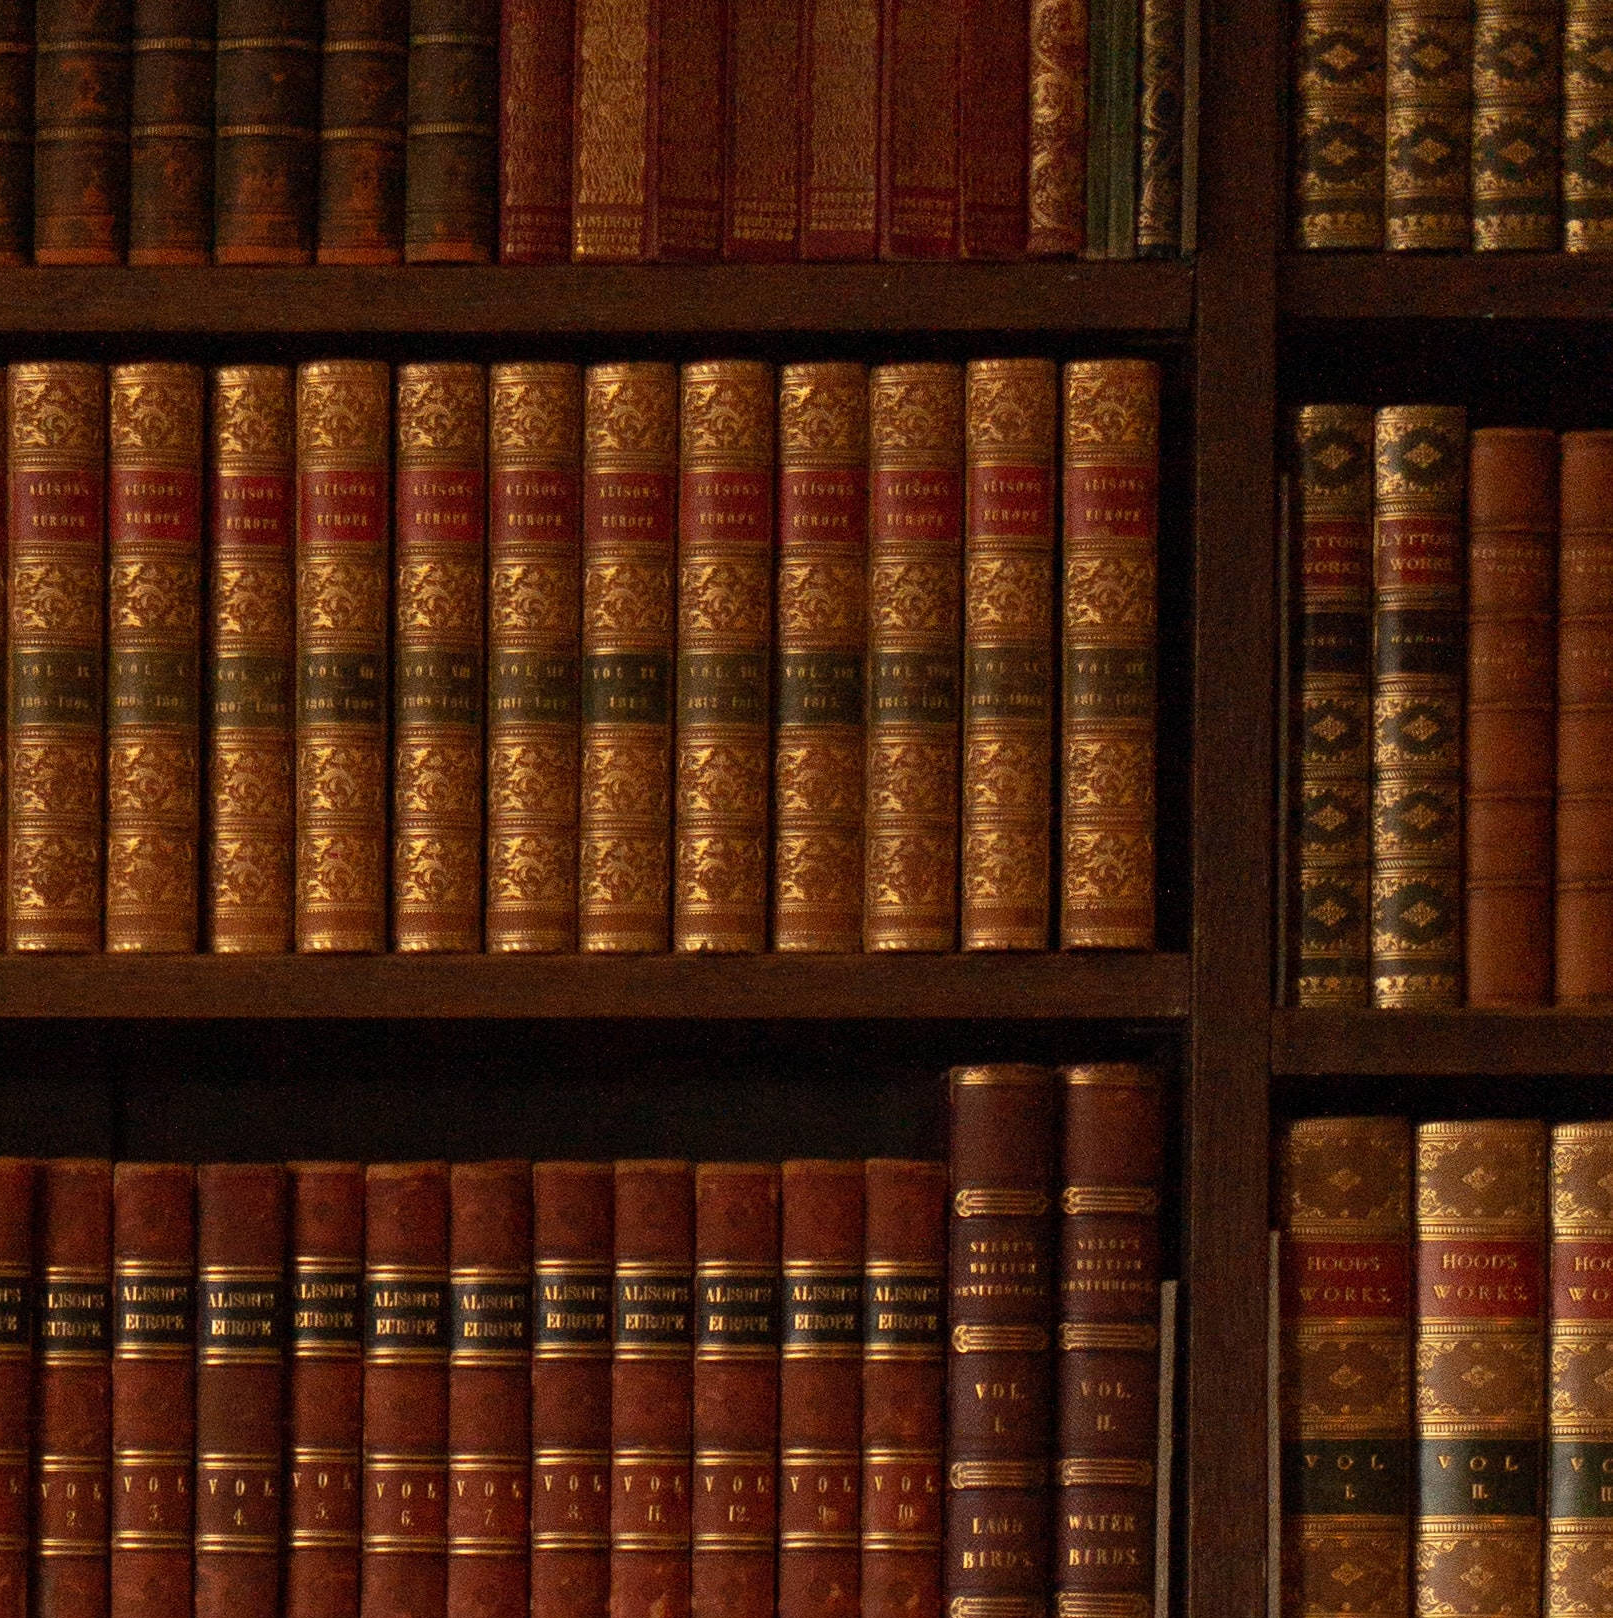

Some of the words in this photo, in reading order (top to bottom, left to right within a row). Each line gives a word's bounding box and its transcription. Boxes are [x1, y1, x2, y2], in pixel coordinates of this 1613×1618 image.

[1299, 1287, 1391, 1302] WORKS.
[1433, 1285, 1527, 1300] WORKS.
[125, 1314, 184, 1330] EUROPE
[211, 1320, 271, 1336] EUROPE
[295, 1312, 354, 1328] EUROPE
[376, 1320, 436, 1335] EUROPE
[546, 1313, 605, 1329] EUROPE
[626, 1314, 684, 1330] EUROPE
[709, 1315, 768, 1332] EUROPE
[795, 1314, 855, 1329] EUROPE
[878, 1314, 937, 1330] EUROPE
[464, 1322, 523, 1337] EUROPE
[973, 1517, 1023, 1534] LAND
[1069, 1515, 1134, 1532] WATER
